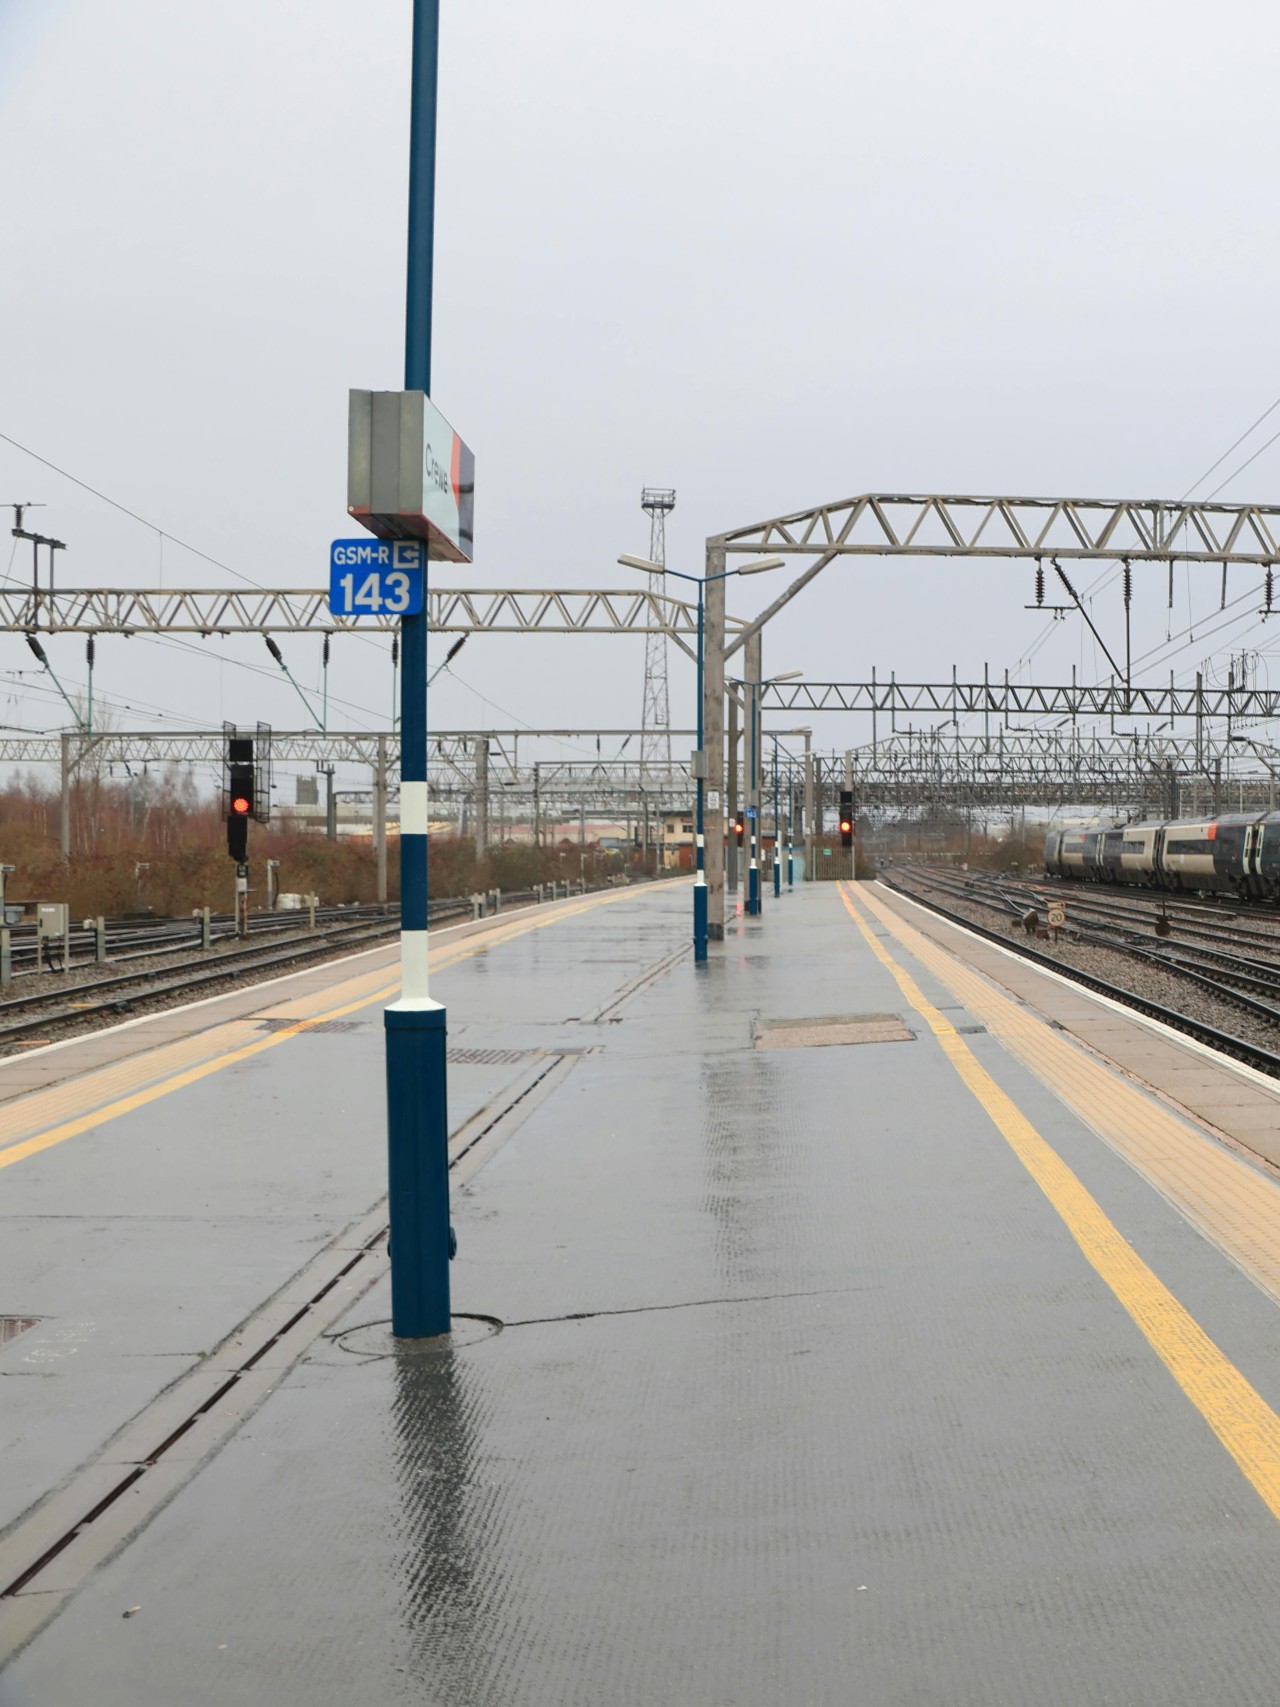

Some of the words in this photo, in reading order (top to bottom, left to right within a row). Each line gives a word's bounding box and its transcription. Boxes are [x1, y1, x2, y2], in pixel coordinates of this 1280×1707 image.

[426, 443, 448, 494] Crewe
[333, 546, 390, 565] GSM-R
[340, 571, 411, 613] 143
[1051, 912, 1062, 922] 20
